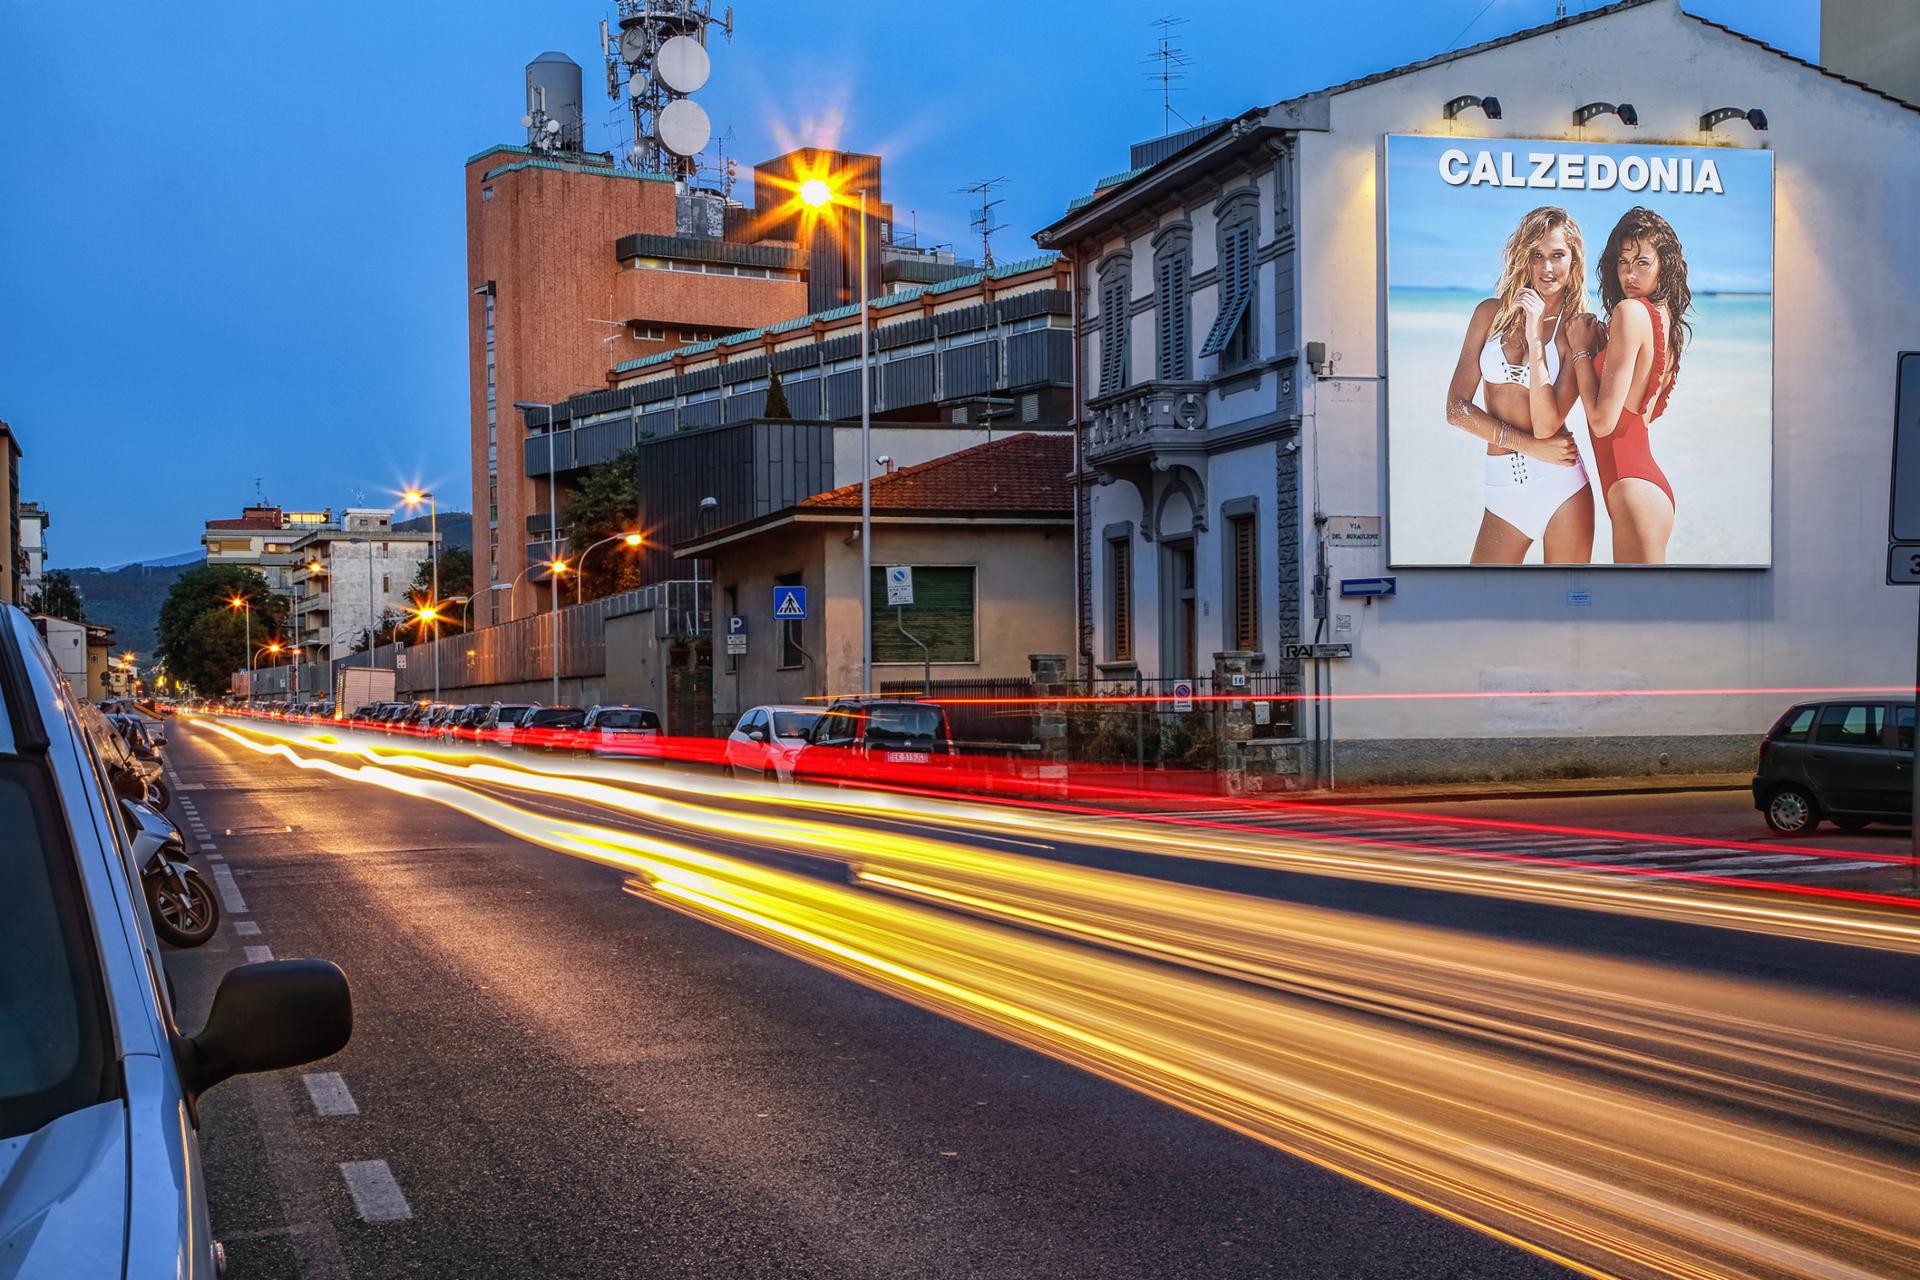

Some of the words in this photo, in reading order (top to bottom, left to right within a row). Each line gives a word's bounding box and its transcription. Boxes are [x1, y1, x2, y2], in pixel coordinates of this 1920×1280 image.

[1439, 149, 1724, 193] CALZEDONIA
[730, 617, 743, 634] P
[1286, 645, 1313, 658] RAI
[1234, 676, 1244, 685] 16
